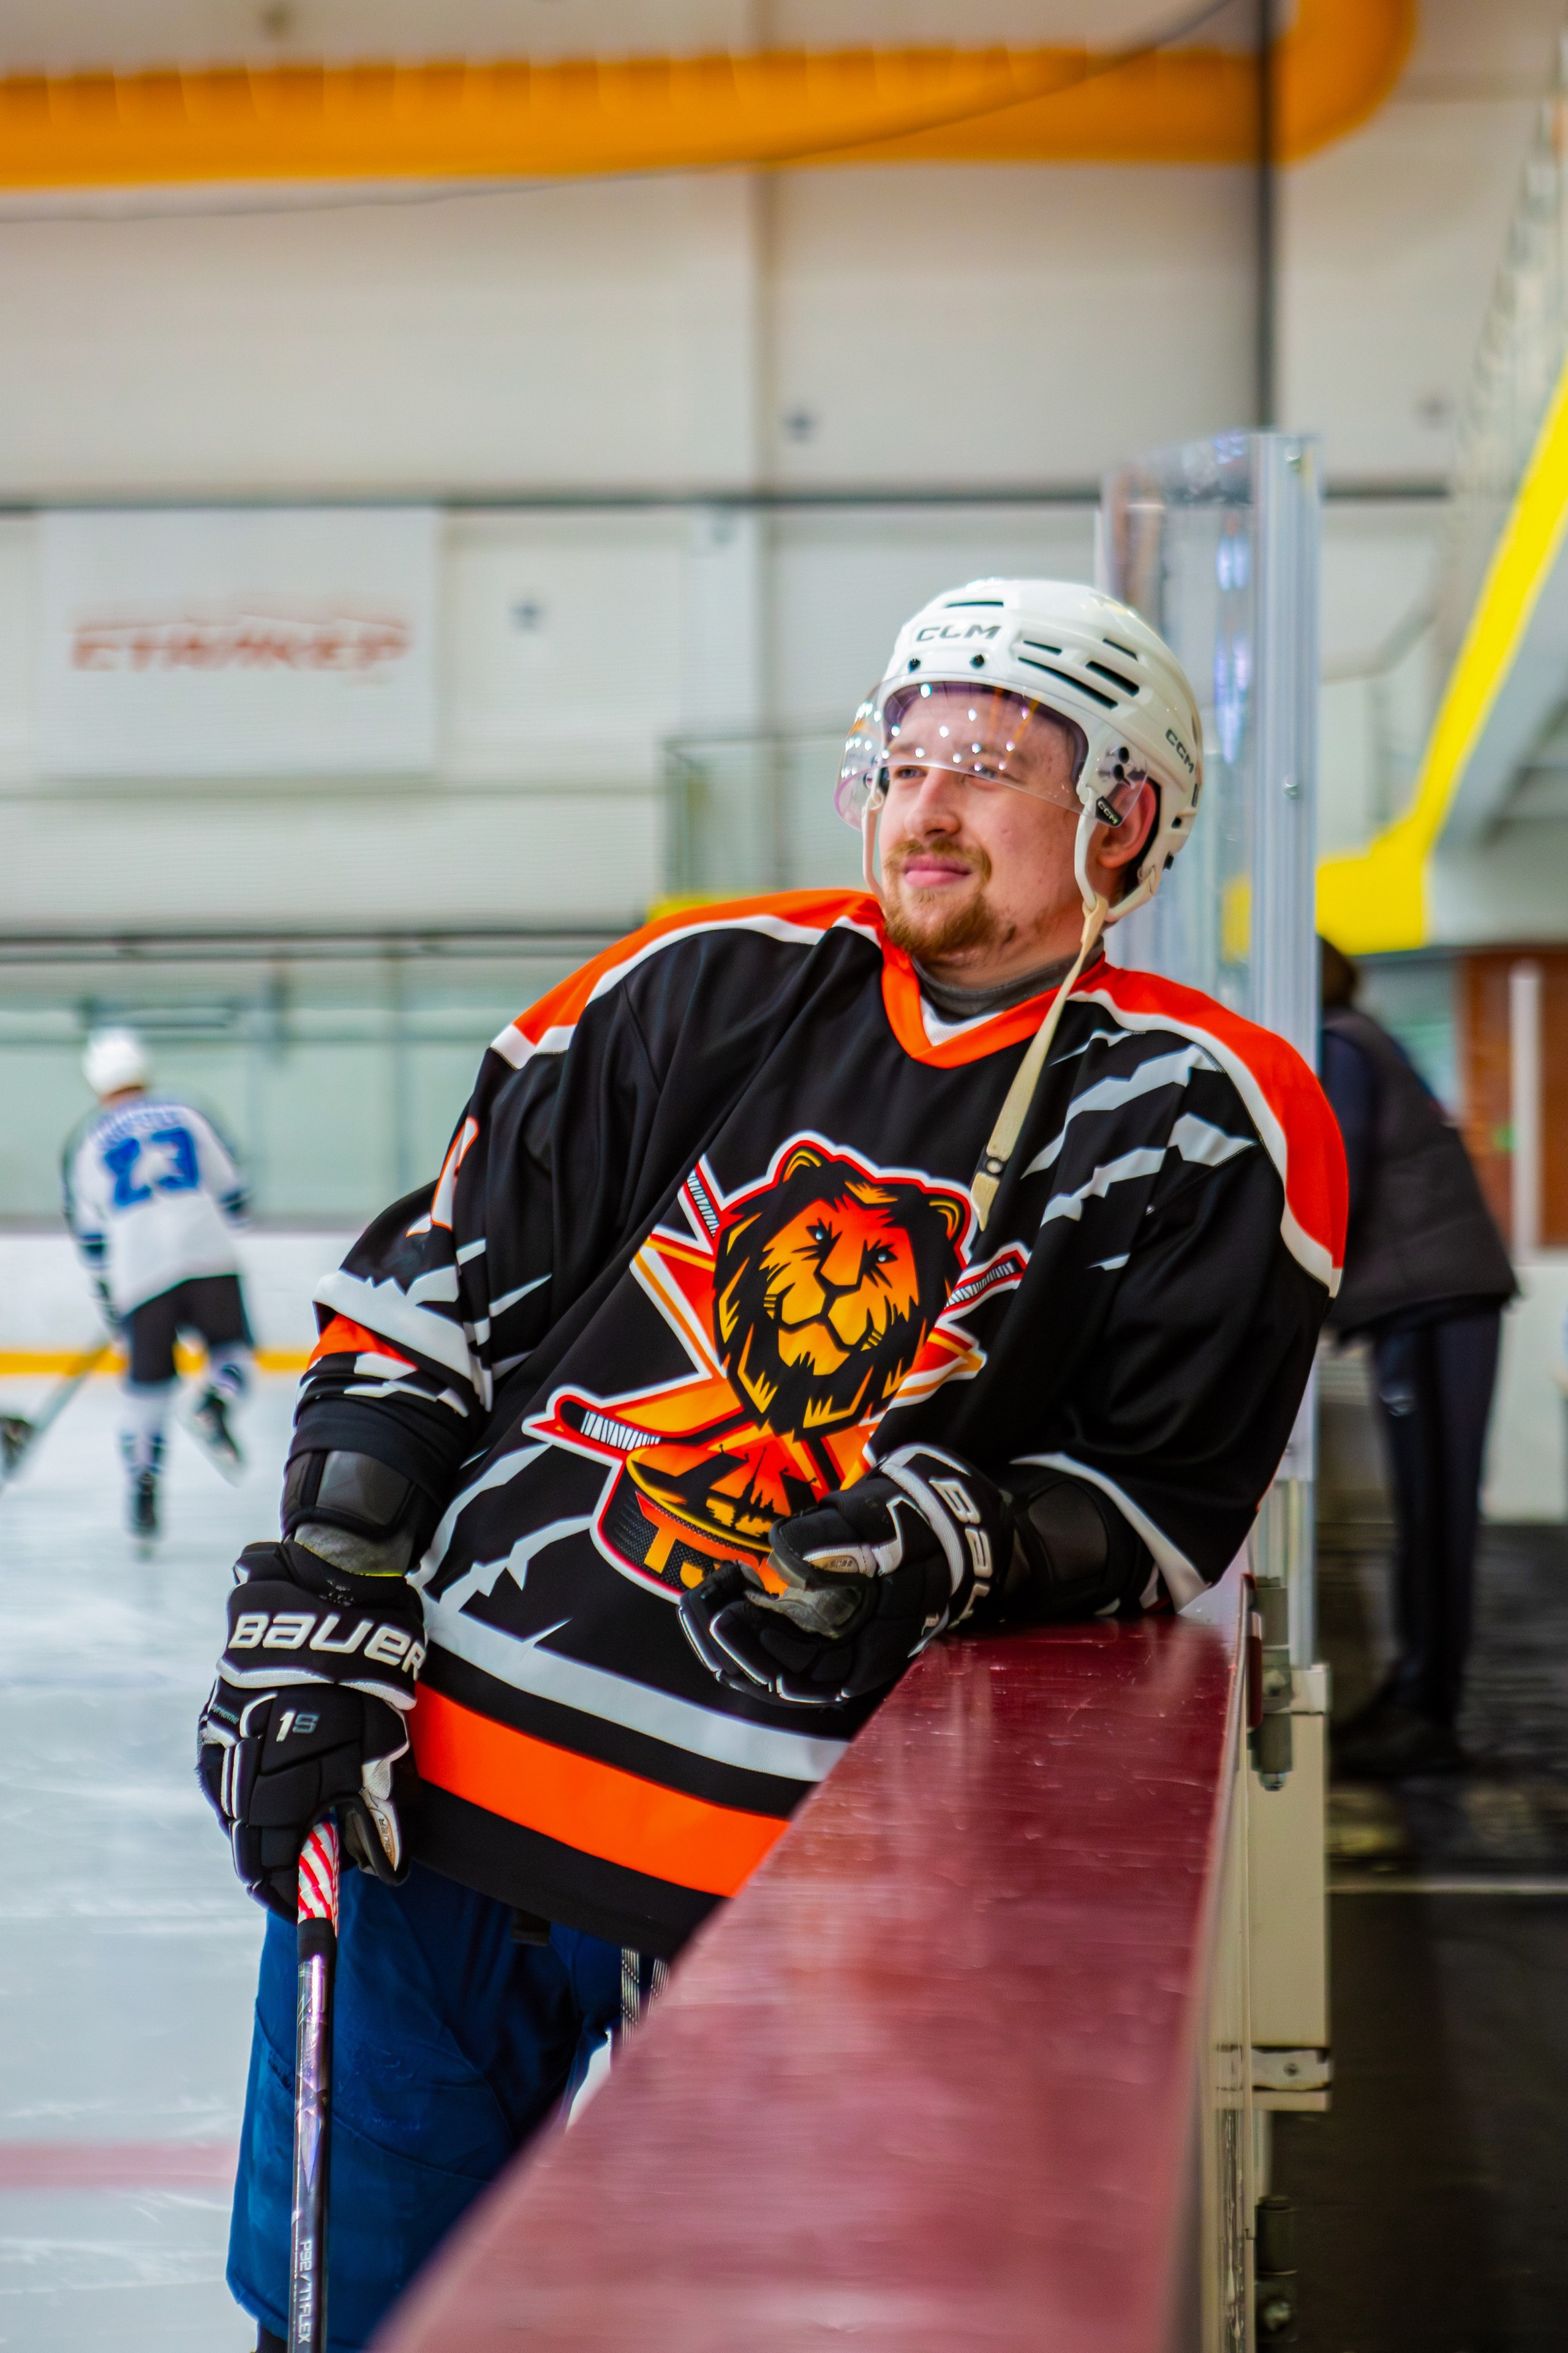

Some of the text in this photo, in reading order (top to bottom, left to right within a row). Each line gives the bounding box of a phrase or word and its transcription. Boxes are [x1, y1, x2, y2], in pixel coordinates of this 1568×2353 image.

[916, 624, 1001, 641] CCM
[1166, 729, 1194, 774] CCM
[1098, 801, 1118, 825] CCM
[228, 1612, 427, 1680] BAUER
